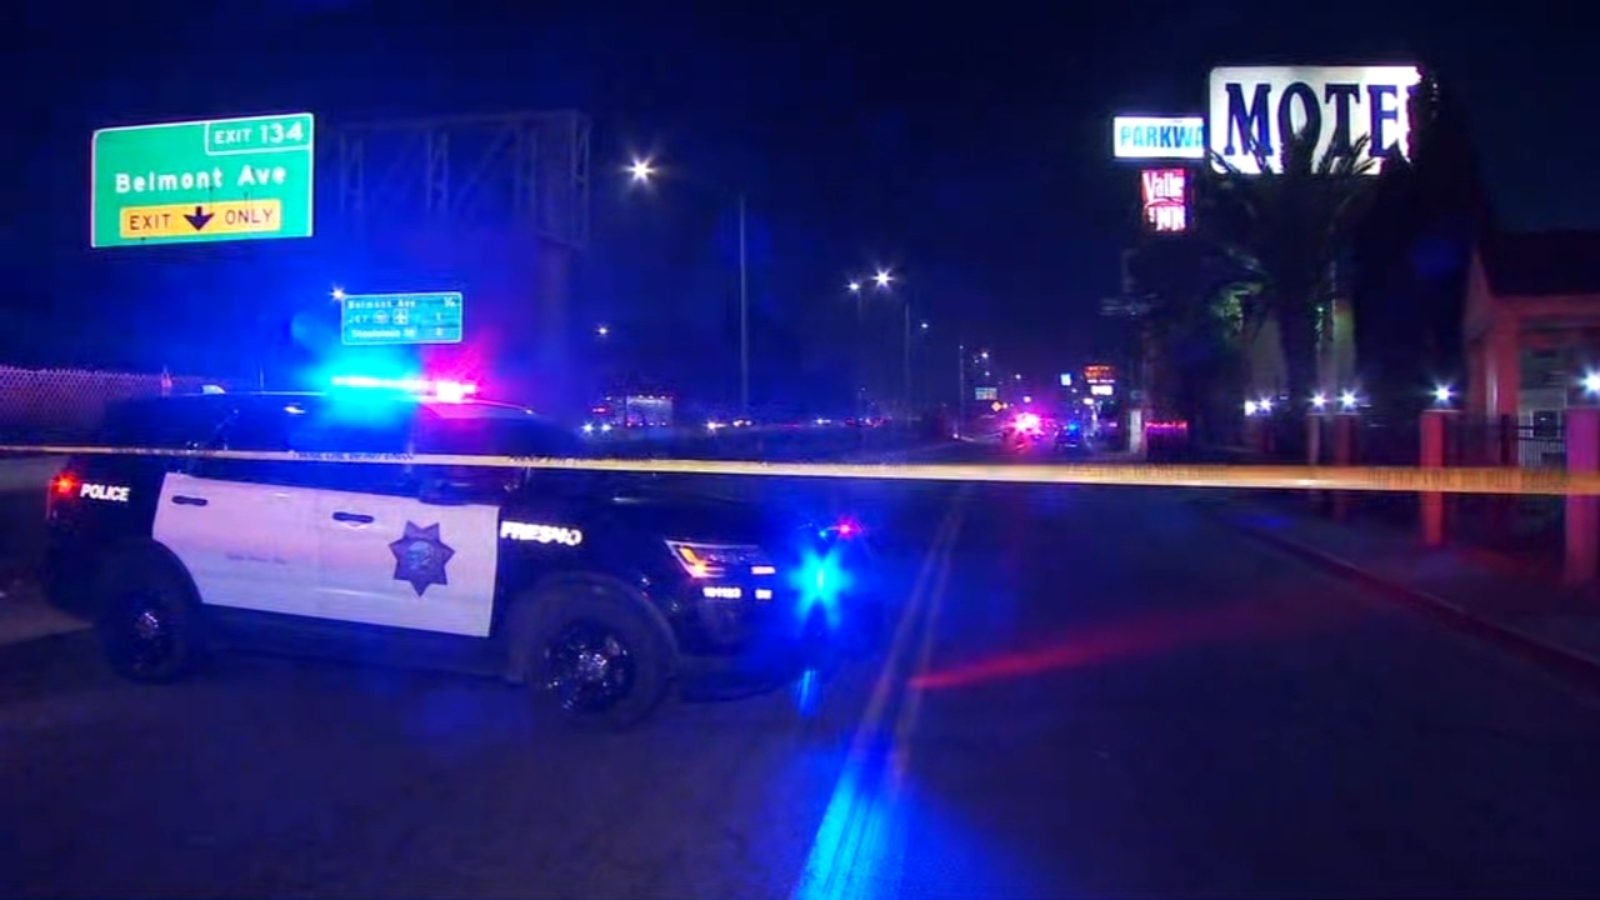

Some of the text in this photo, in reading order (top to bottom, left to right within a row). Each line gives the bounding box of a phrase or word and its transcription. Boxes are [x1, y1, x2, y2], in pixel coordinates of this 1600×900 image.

[1224, 82, 1418, 156] MOTE
[214, 122, 304, 145] EXIT 134
[115, 164, 287, 193] Belmont Ave
[129, 208, 274, 231] EXIT ONLY
[80, 483, 131, 502] POLICE
